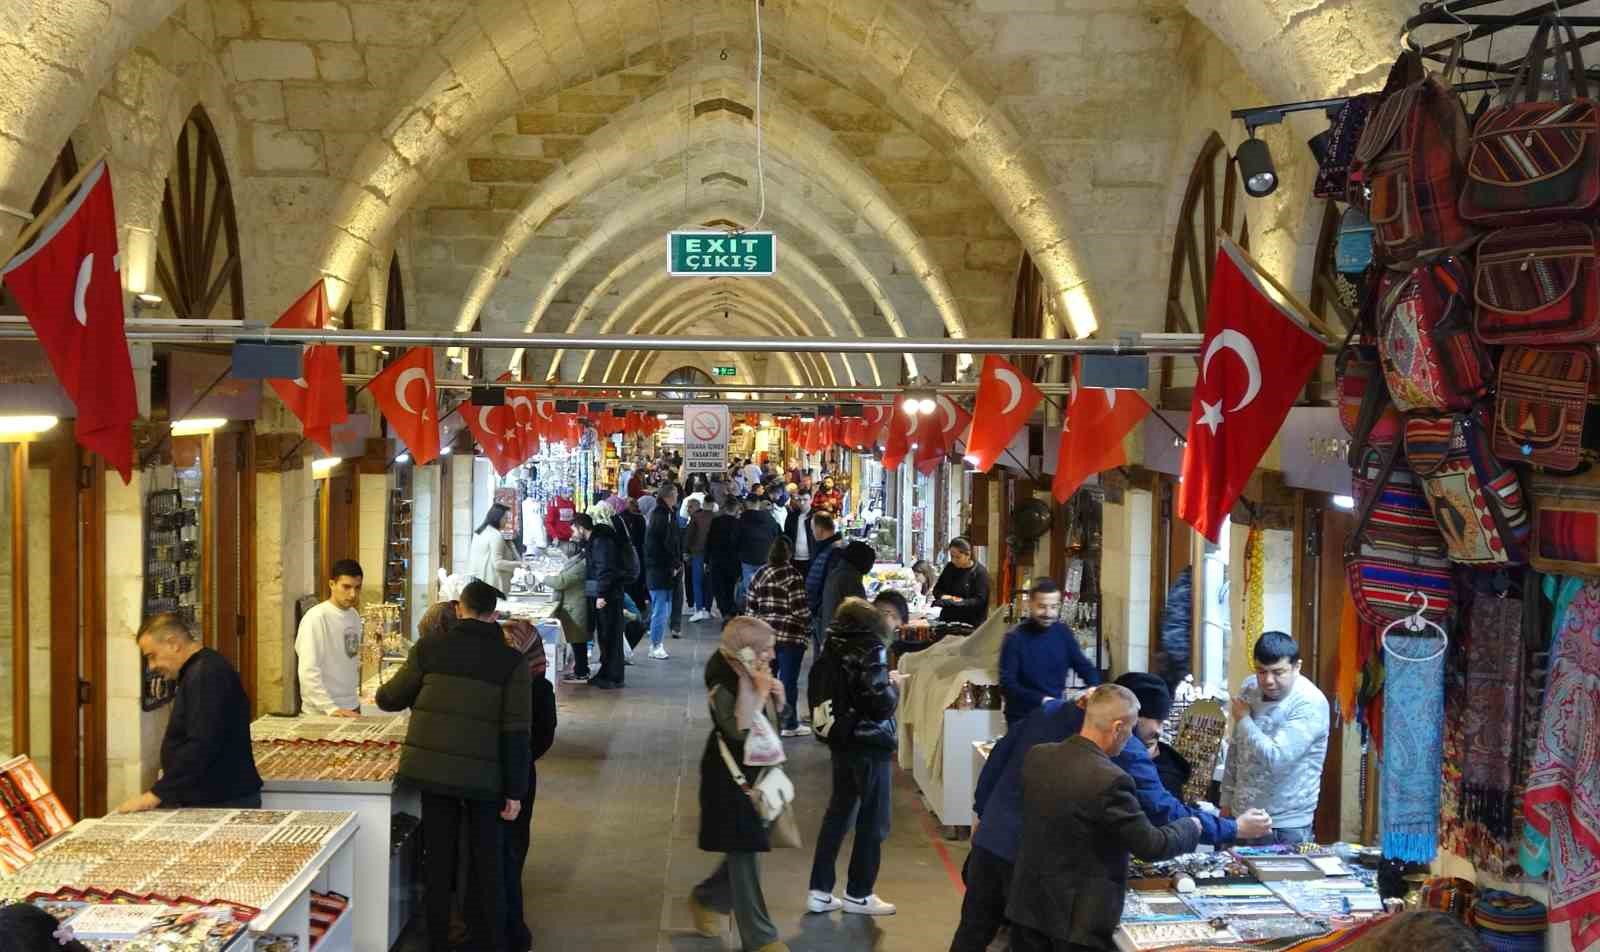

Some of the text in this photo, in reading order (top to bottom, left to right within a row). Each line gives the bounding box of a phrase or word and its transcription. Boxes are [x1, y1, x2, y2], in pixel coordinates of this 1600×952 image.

[719, 47, 728, 61] 6
[685, 239, 758, 253] EXIT
[686, 255, 758, 270] ÇIKIŞ
